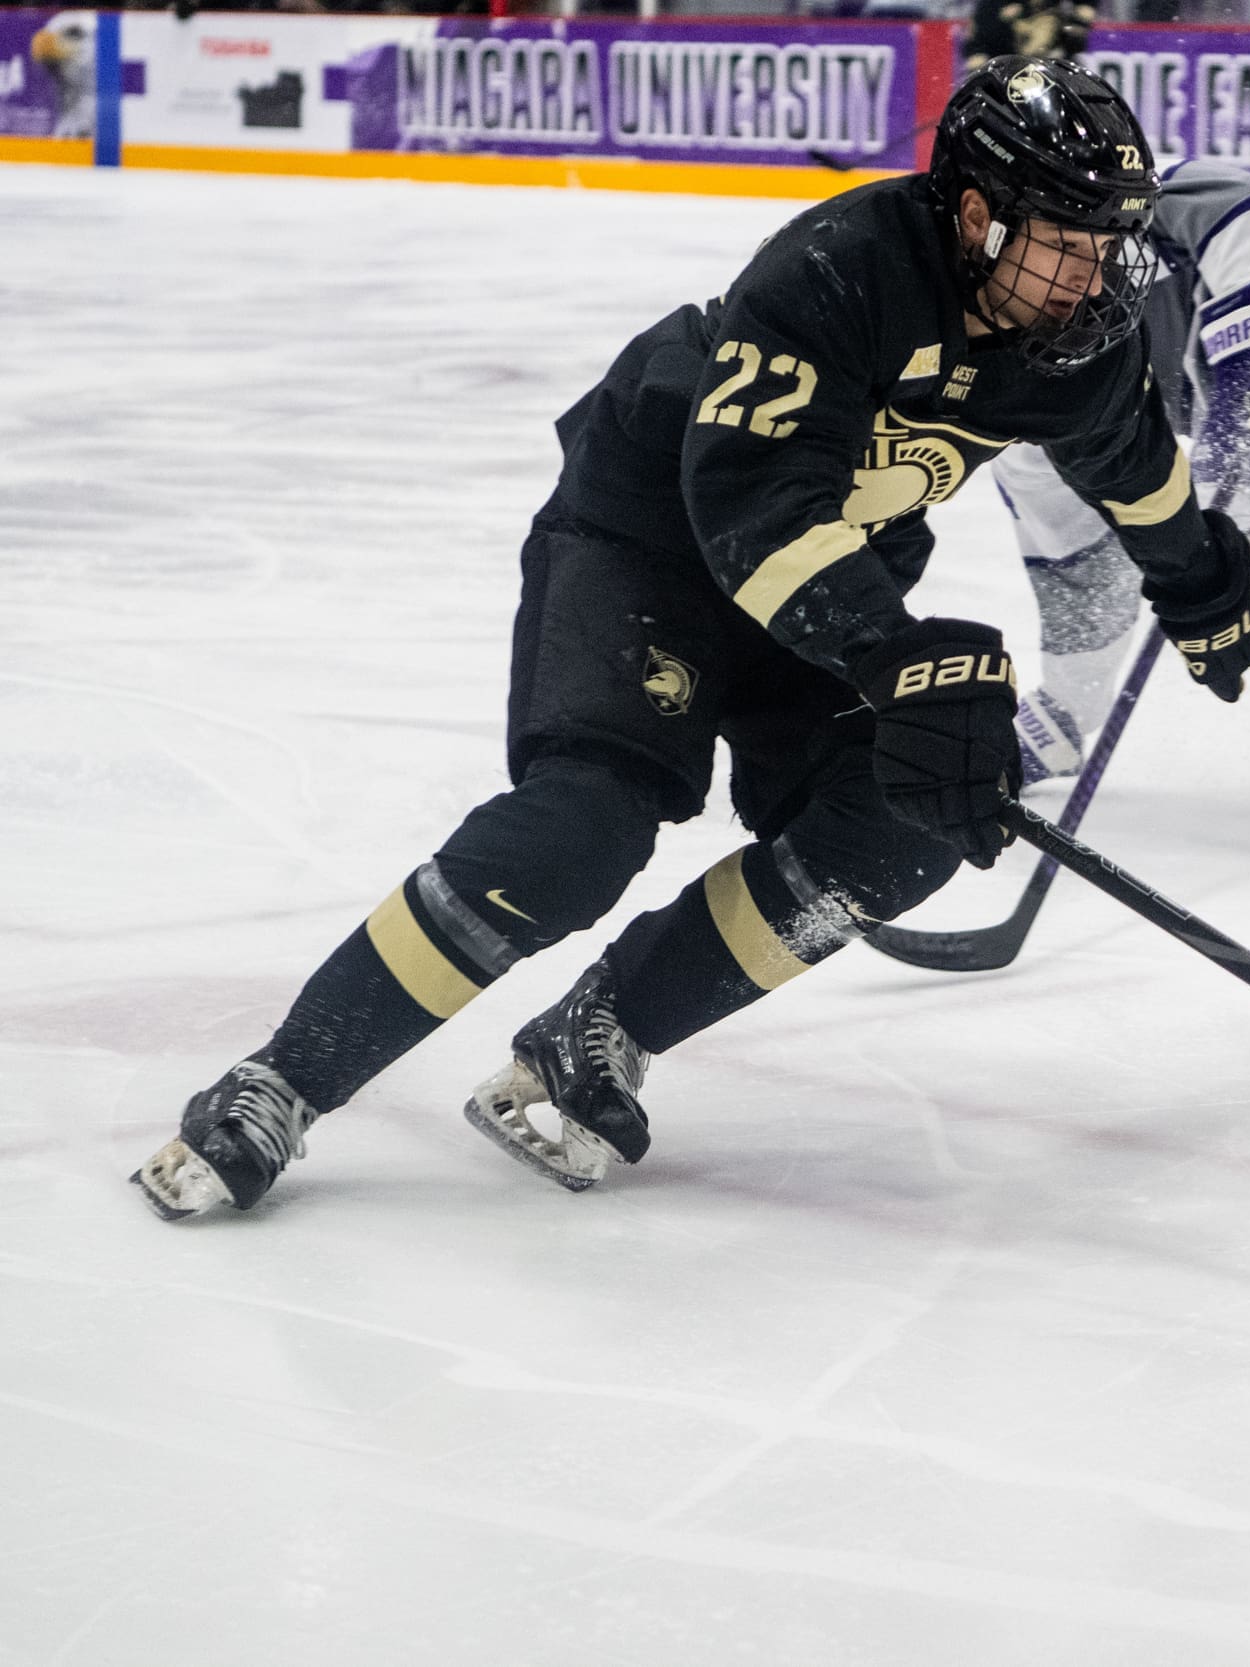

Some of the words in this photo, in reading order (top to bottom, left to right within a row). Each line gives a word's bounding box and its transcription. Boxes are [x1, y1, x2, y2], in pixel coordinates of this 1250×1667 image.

[397, 38, 599, 143] NIAGARA
[608, 41, 895, 152] UNIVERSITY
[1115, 144, 1144, 171] 22
[1120, 197, 1148, 211] ARMY
[951, 363, 979, 384] WEST
[695, 340, 818, 439] 22
[941, 381, 972, 401] POINT
